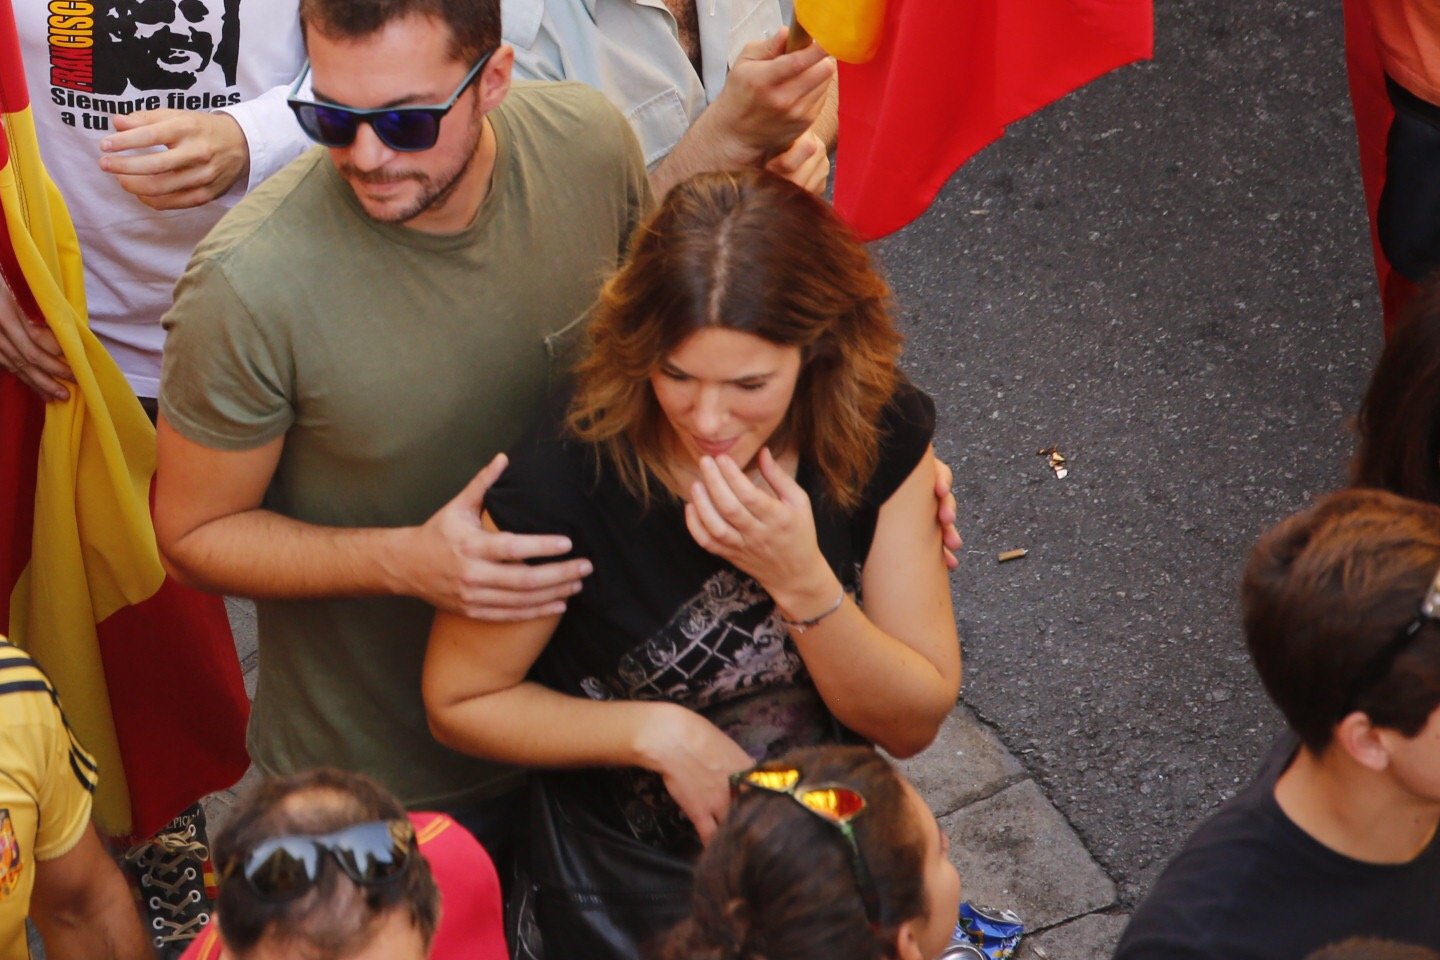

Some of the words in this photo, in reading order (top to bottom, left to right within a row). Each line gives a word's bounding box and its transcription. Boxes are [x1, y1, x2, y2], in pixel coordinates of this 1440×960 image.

[50, 87, 160, 116] Siempre
[167, 92, 241, 110] fieles
[61, 112, 75, 127] a
[82, 112, 109, 131] tu
